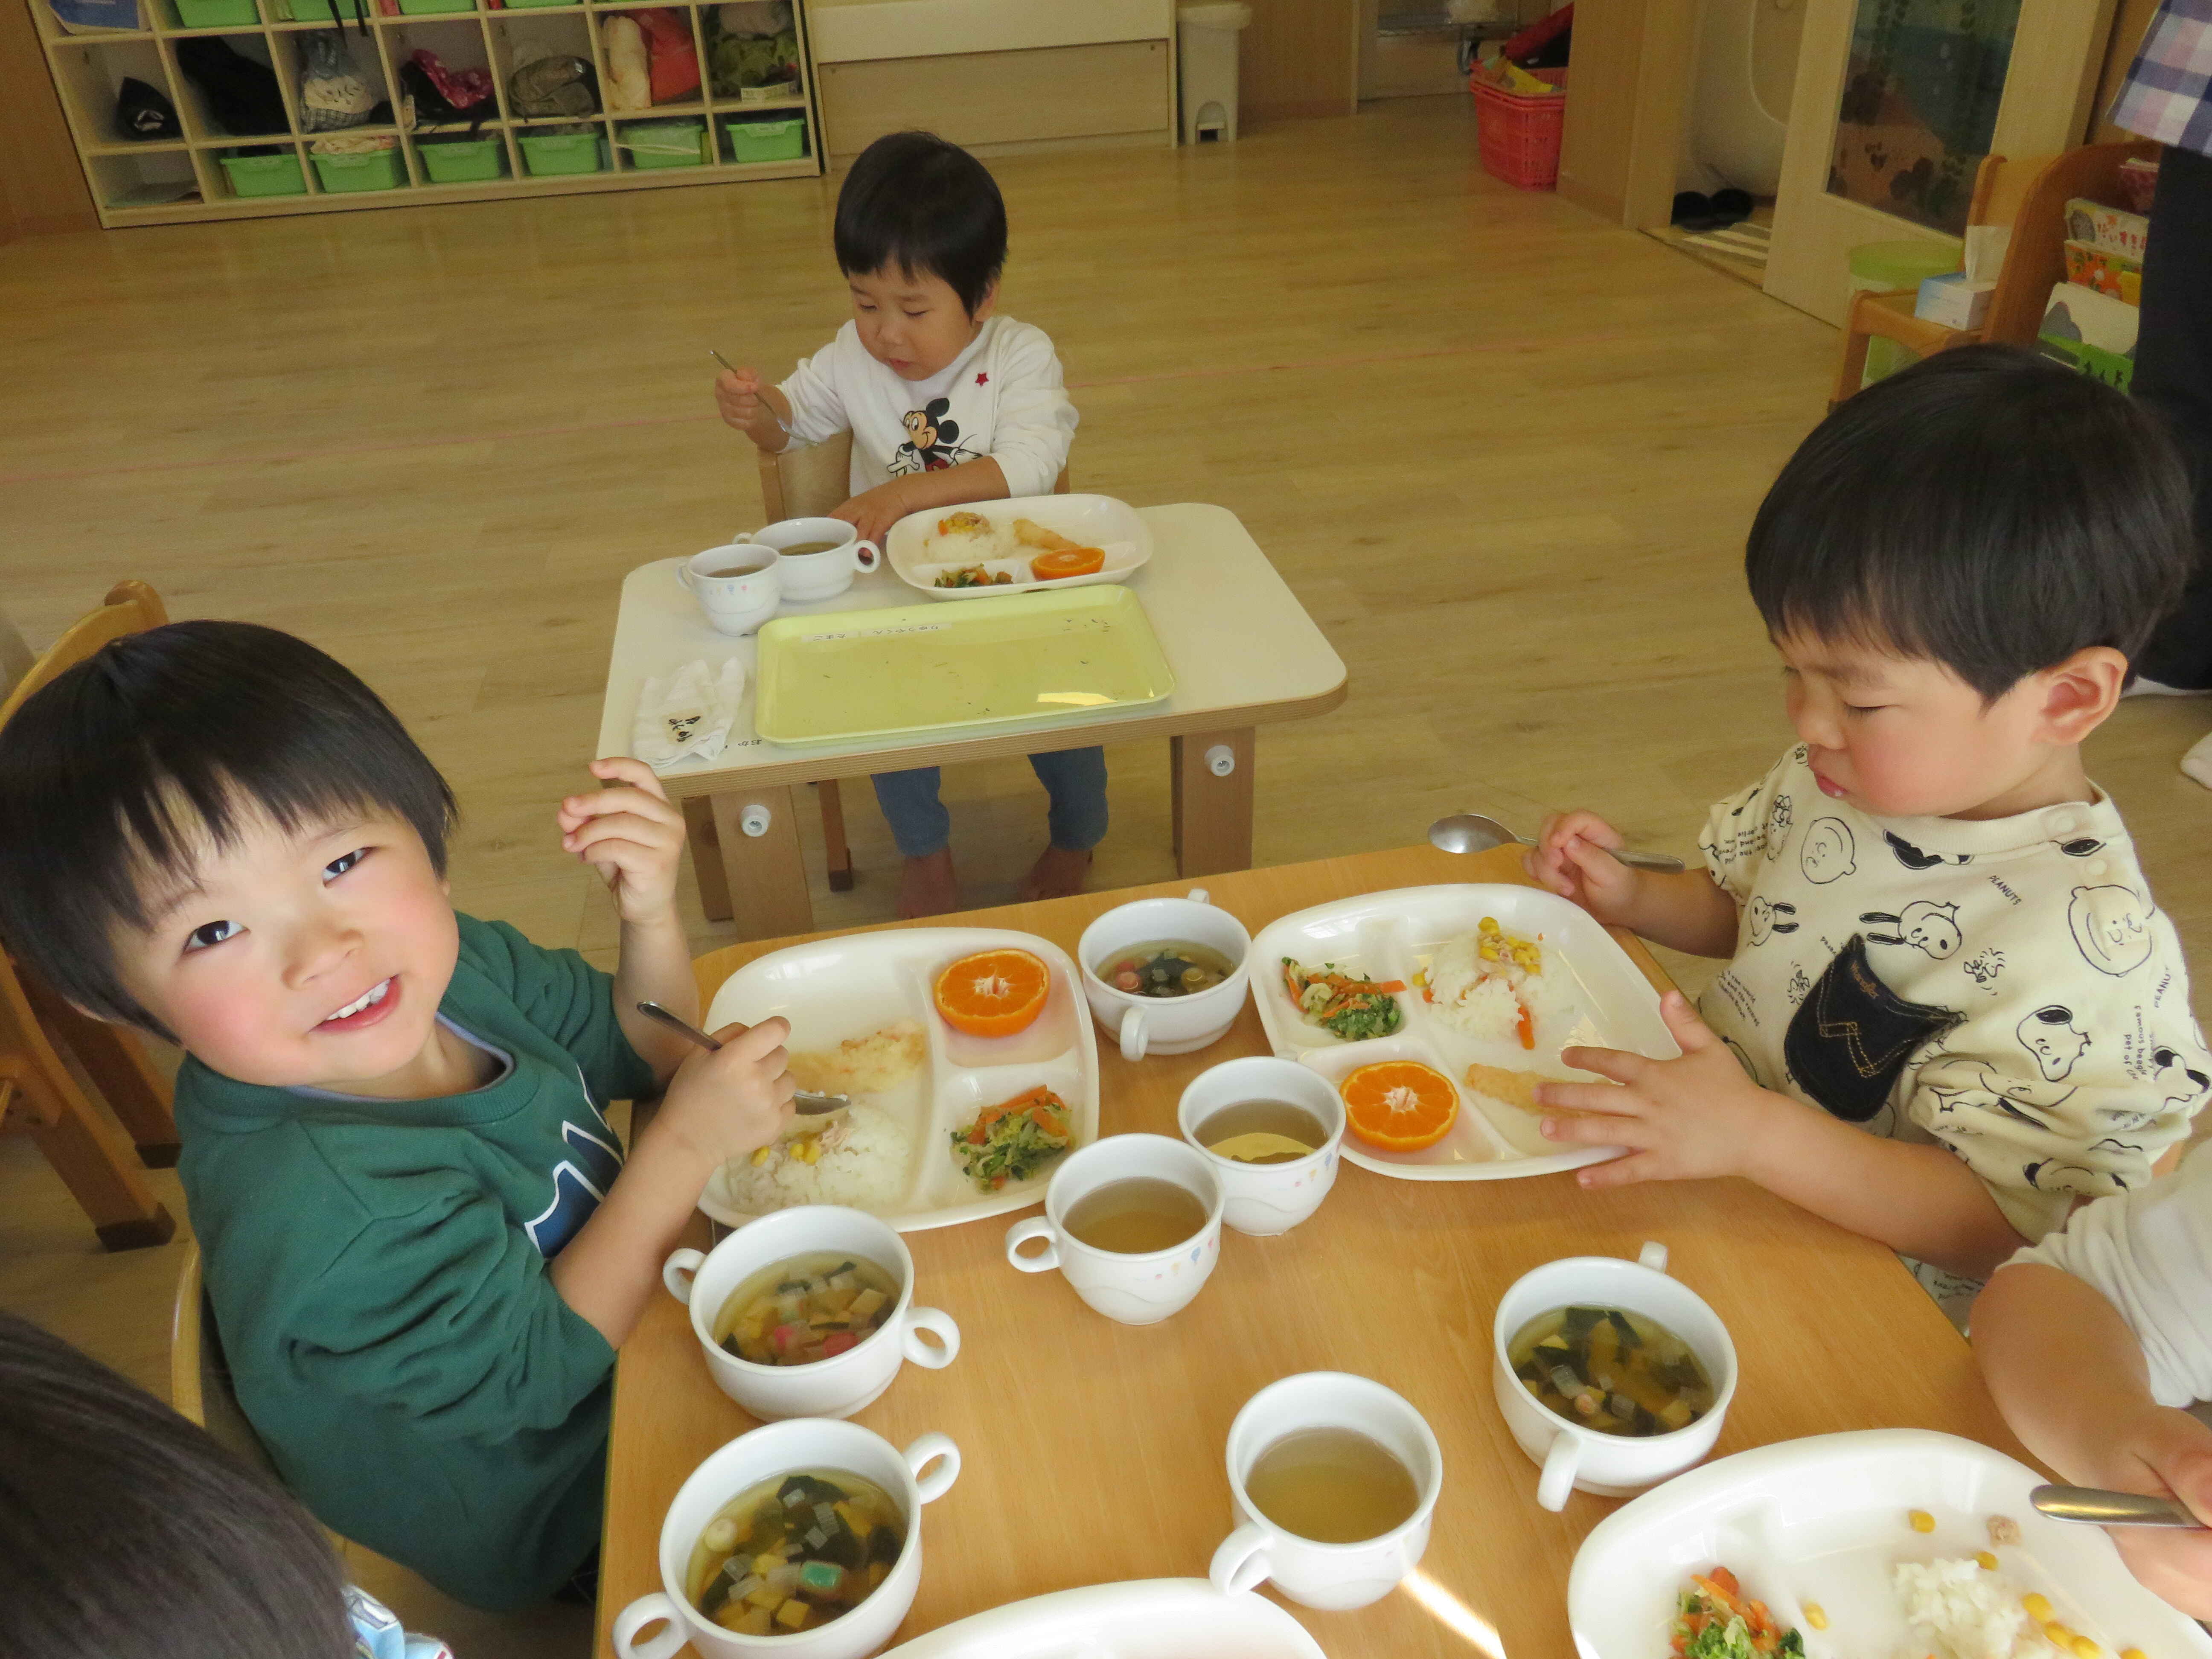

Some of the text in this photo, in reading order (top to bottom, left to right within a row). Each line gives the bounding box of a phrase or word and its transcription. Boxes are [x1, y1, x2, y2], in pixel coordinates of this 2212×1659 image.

[1988, 875, 2022, 905] PEANUTS
[2134, 1005, 2145, 1044] famous
[2123, 1034, 2133, 1050] pet
[2123, 1054, 2133, 1065] of
